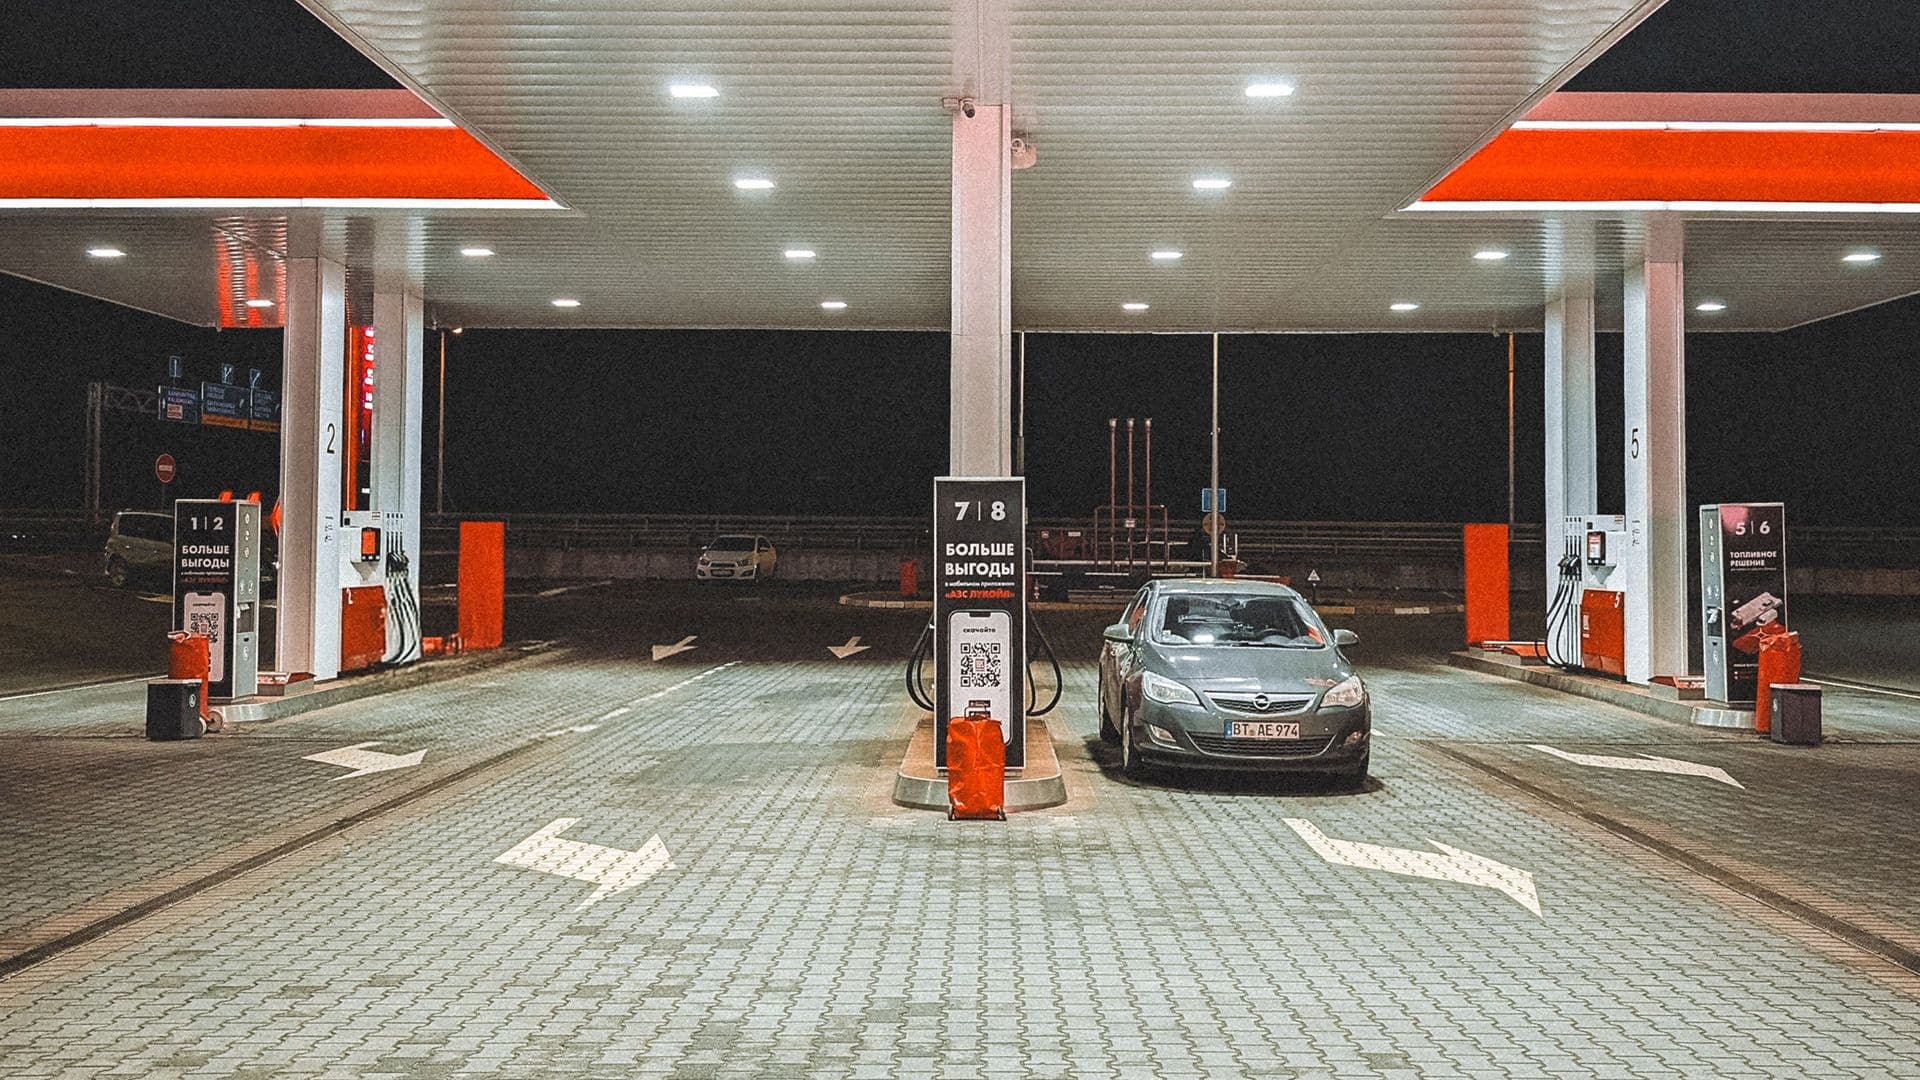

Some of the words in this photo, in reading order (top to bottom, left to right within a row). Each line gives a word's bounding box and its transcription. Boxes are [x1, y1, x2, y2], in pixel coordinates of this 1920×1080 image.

[326, 422, 336, 454] 2
[1631, 428, 1640, 459] 5
[954, 501, 970, 521] 7
[990, 501, 1006, 521] 8
[190, 517, 198, 530] 1
[213, 517, 224, 530] 2
[1735, 522, 1746, 535] 5
[1759, 521, 1771, 534] 6
[182, 545, 230, 554] БОЛЬШЕ
[945, 543, 1015, 556] БОЛЬШЕ
[181, 558, 230, 569] ВЫГОДЫ
[945, 562, 1015, 577] ВЫГОДЫ
[1233, 723, 1249, 735] BT
[1257, 724, 1274, 736] AE
[1275, 724, 1298, 737] 974
